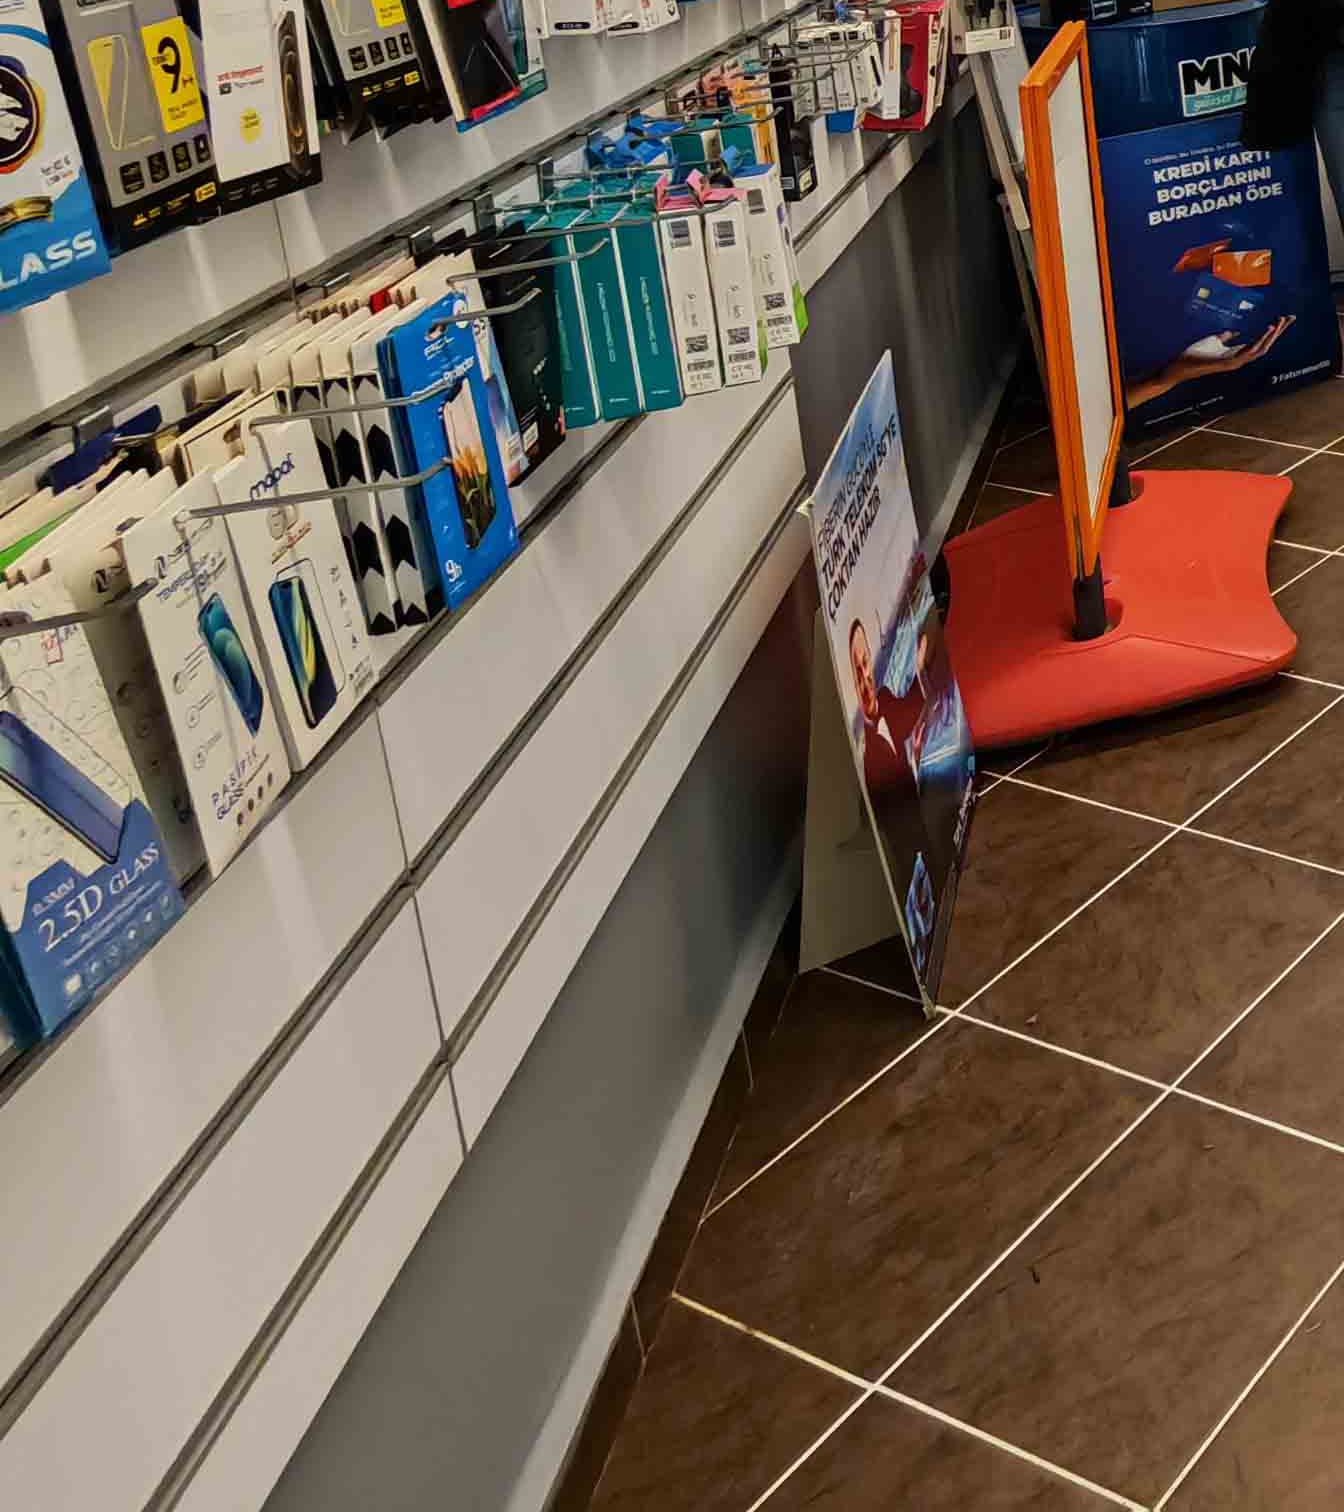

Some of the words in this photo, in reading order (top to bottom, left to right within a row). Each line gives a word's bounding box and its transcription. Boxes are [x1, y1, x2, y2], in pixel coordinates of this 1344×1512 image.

[1178, 45, 1257, 93] MN
[1153, 154, 1212, 184] KREDİ
[1214, 150, 1271, 171] KARTI
[1156, 166, 1272, 203] BORÇLARINI
[1148, 192, 1242, 226] BURADAN
[1246, 182, 1284, 201] ÖDE
